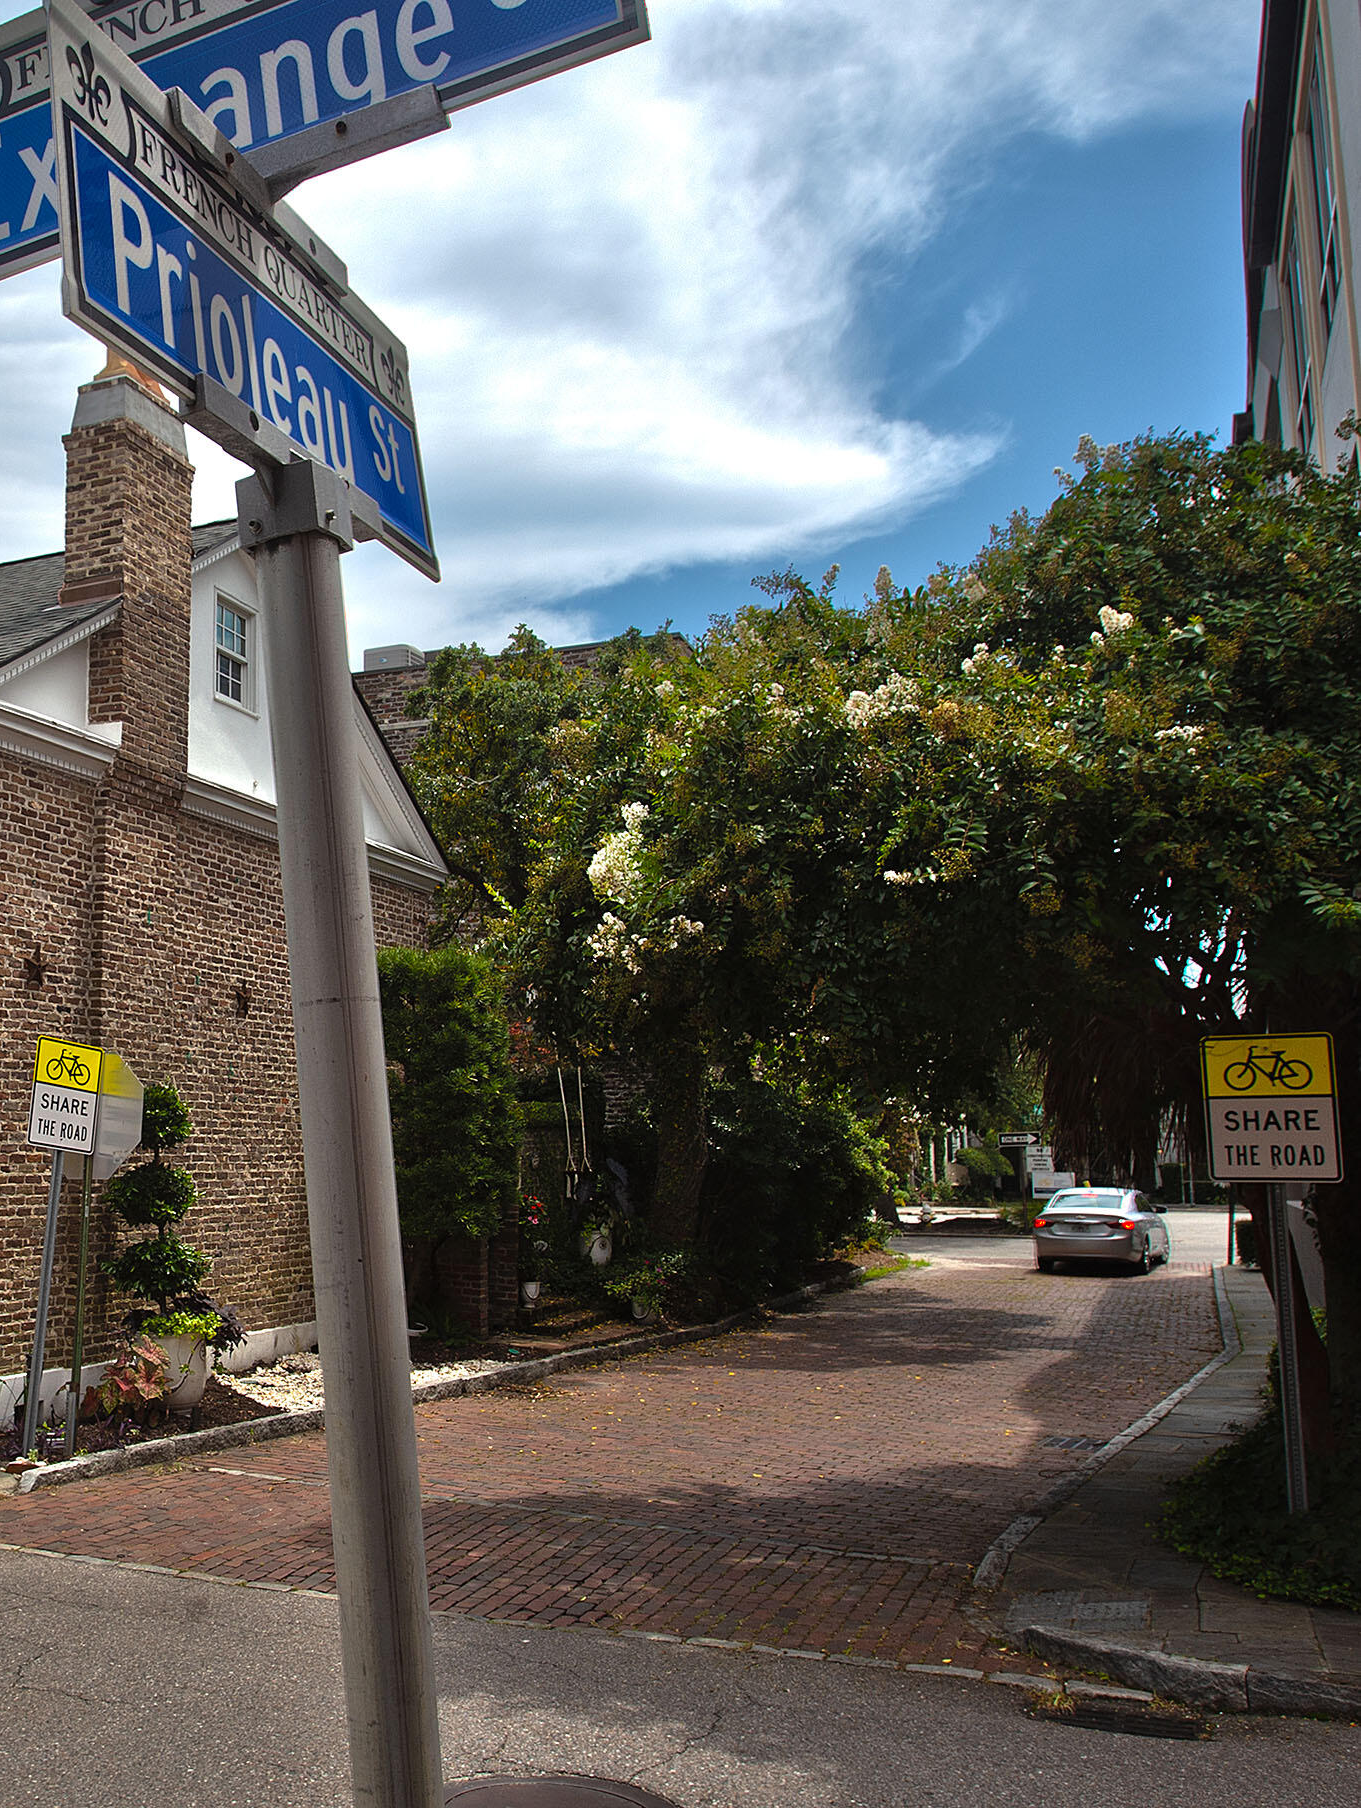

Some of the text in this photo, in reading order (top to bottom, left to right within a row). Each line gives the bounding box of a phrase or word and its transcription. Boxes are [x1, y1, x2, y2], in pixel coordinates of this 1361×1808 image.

[15, 0, 206, 90] FNCH
[137, 119, 370, 371] FRENCH QUARTER
[108, 170, 405, 495] Prioleau St
[40, 1092, 89, 1117] SHARE
[37, 1117, 88, 1142] THE ROAD
[1223, 1109, 1321, 1132] SHARE
[1223, 1144, 1326, 1167] THE ROAD
